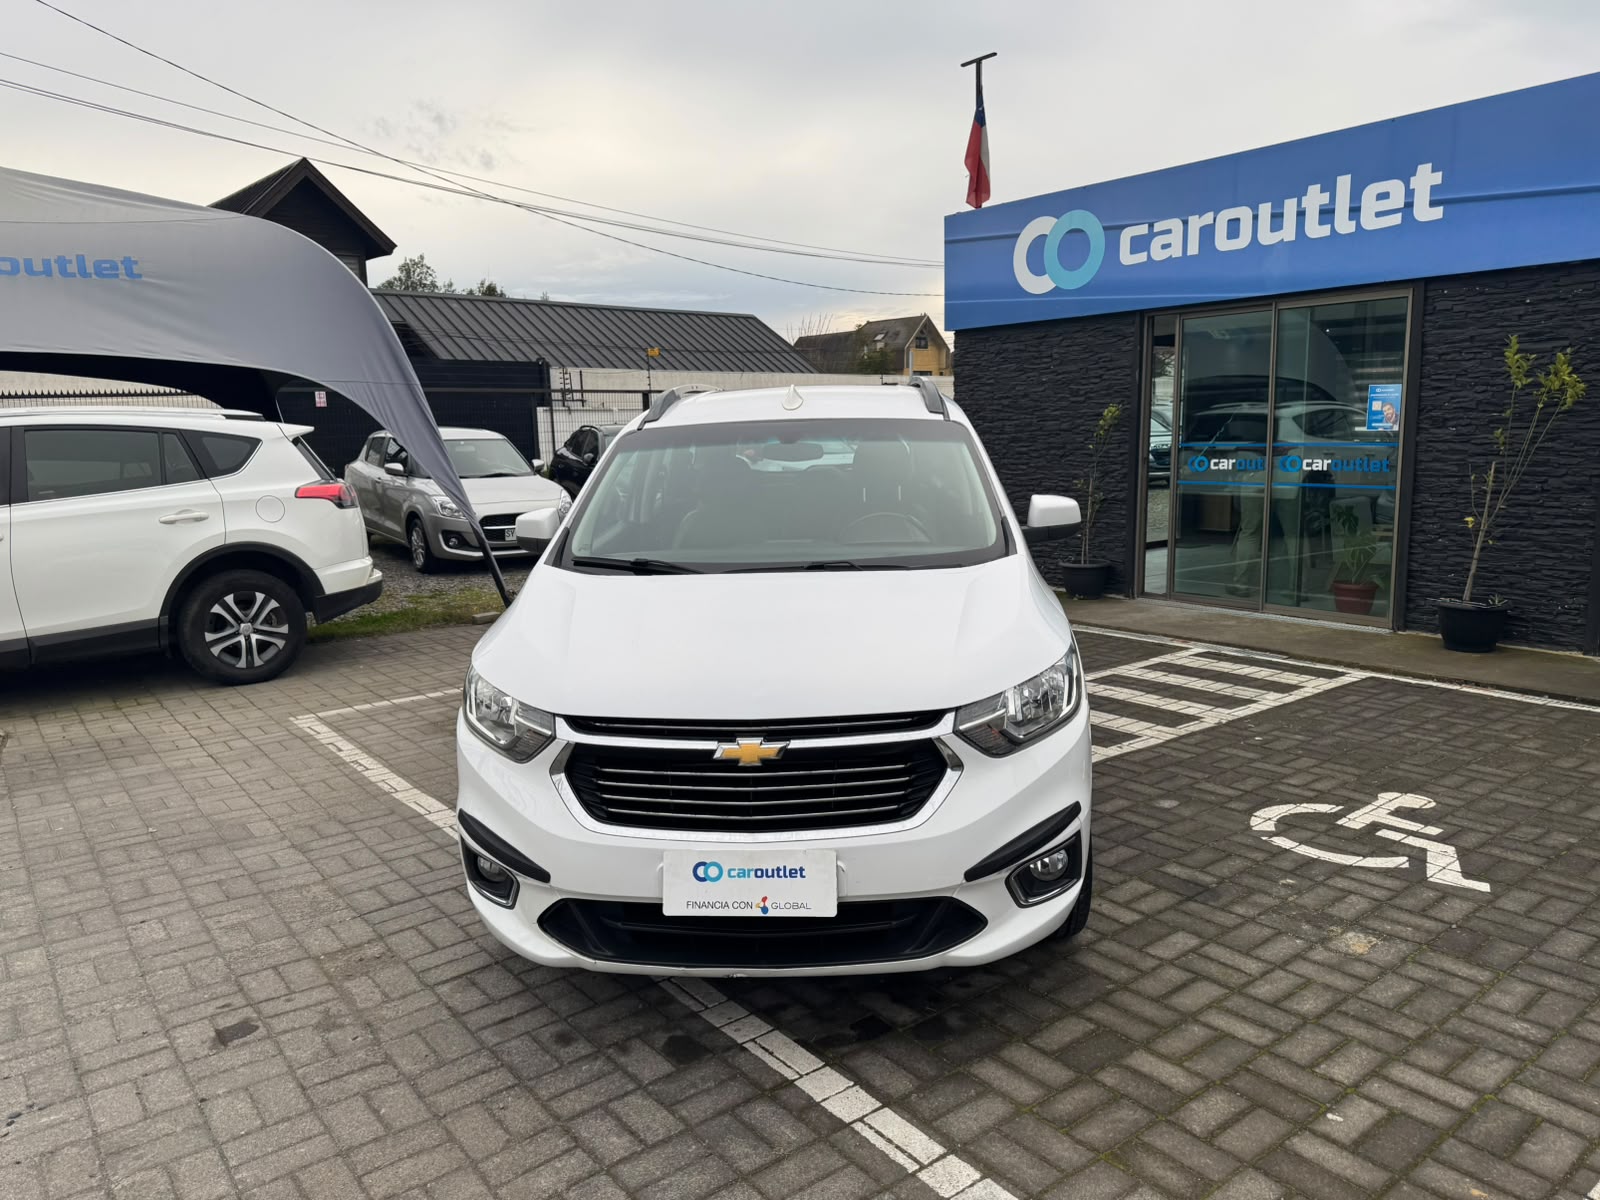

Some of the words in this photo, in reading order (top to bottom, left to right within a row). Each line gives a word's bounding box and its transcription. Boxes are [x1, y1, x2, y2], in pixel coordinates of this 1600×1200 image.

[1119, 162, 1444, 266] caroutlet
[0, 254, 143, 279] outlet
[1302, 457, 1390, 473] caroutlet
[727, 865, 806, 878] caroutlet
[686, 900, 729, 909] FINANCIA
[731, 900, 753, 909] CON
[771, 901, 812, 910] GLOBAL
